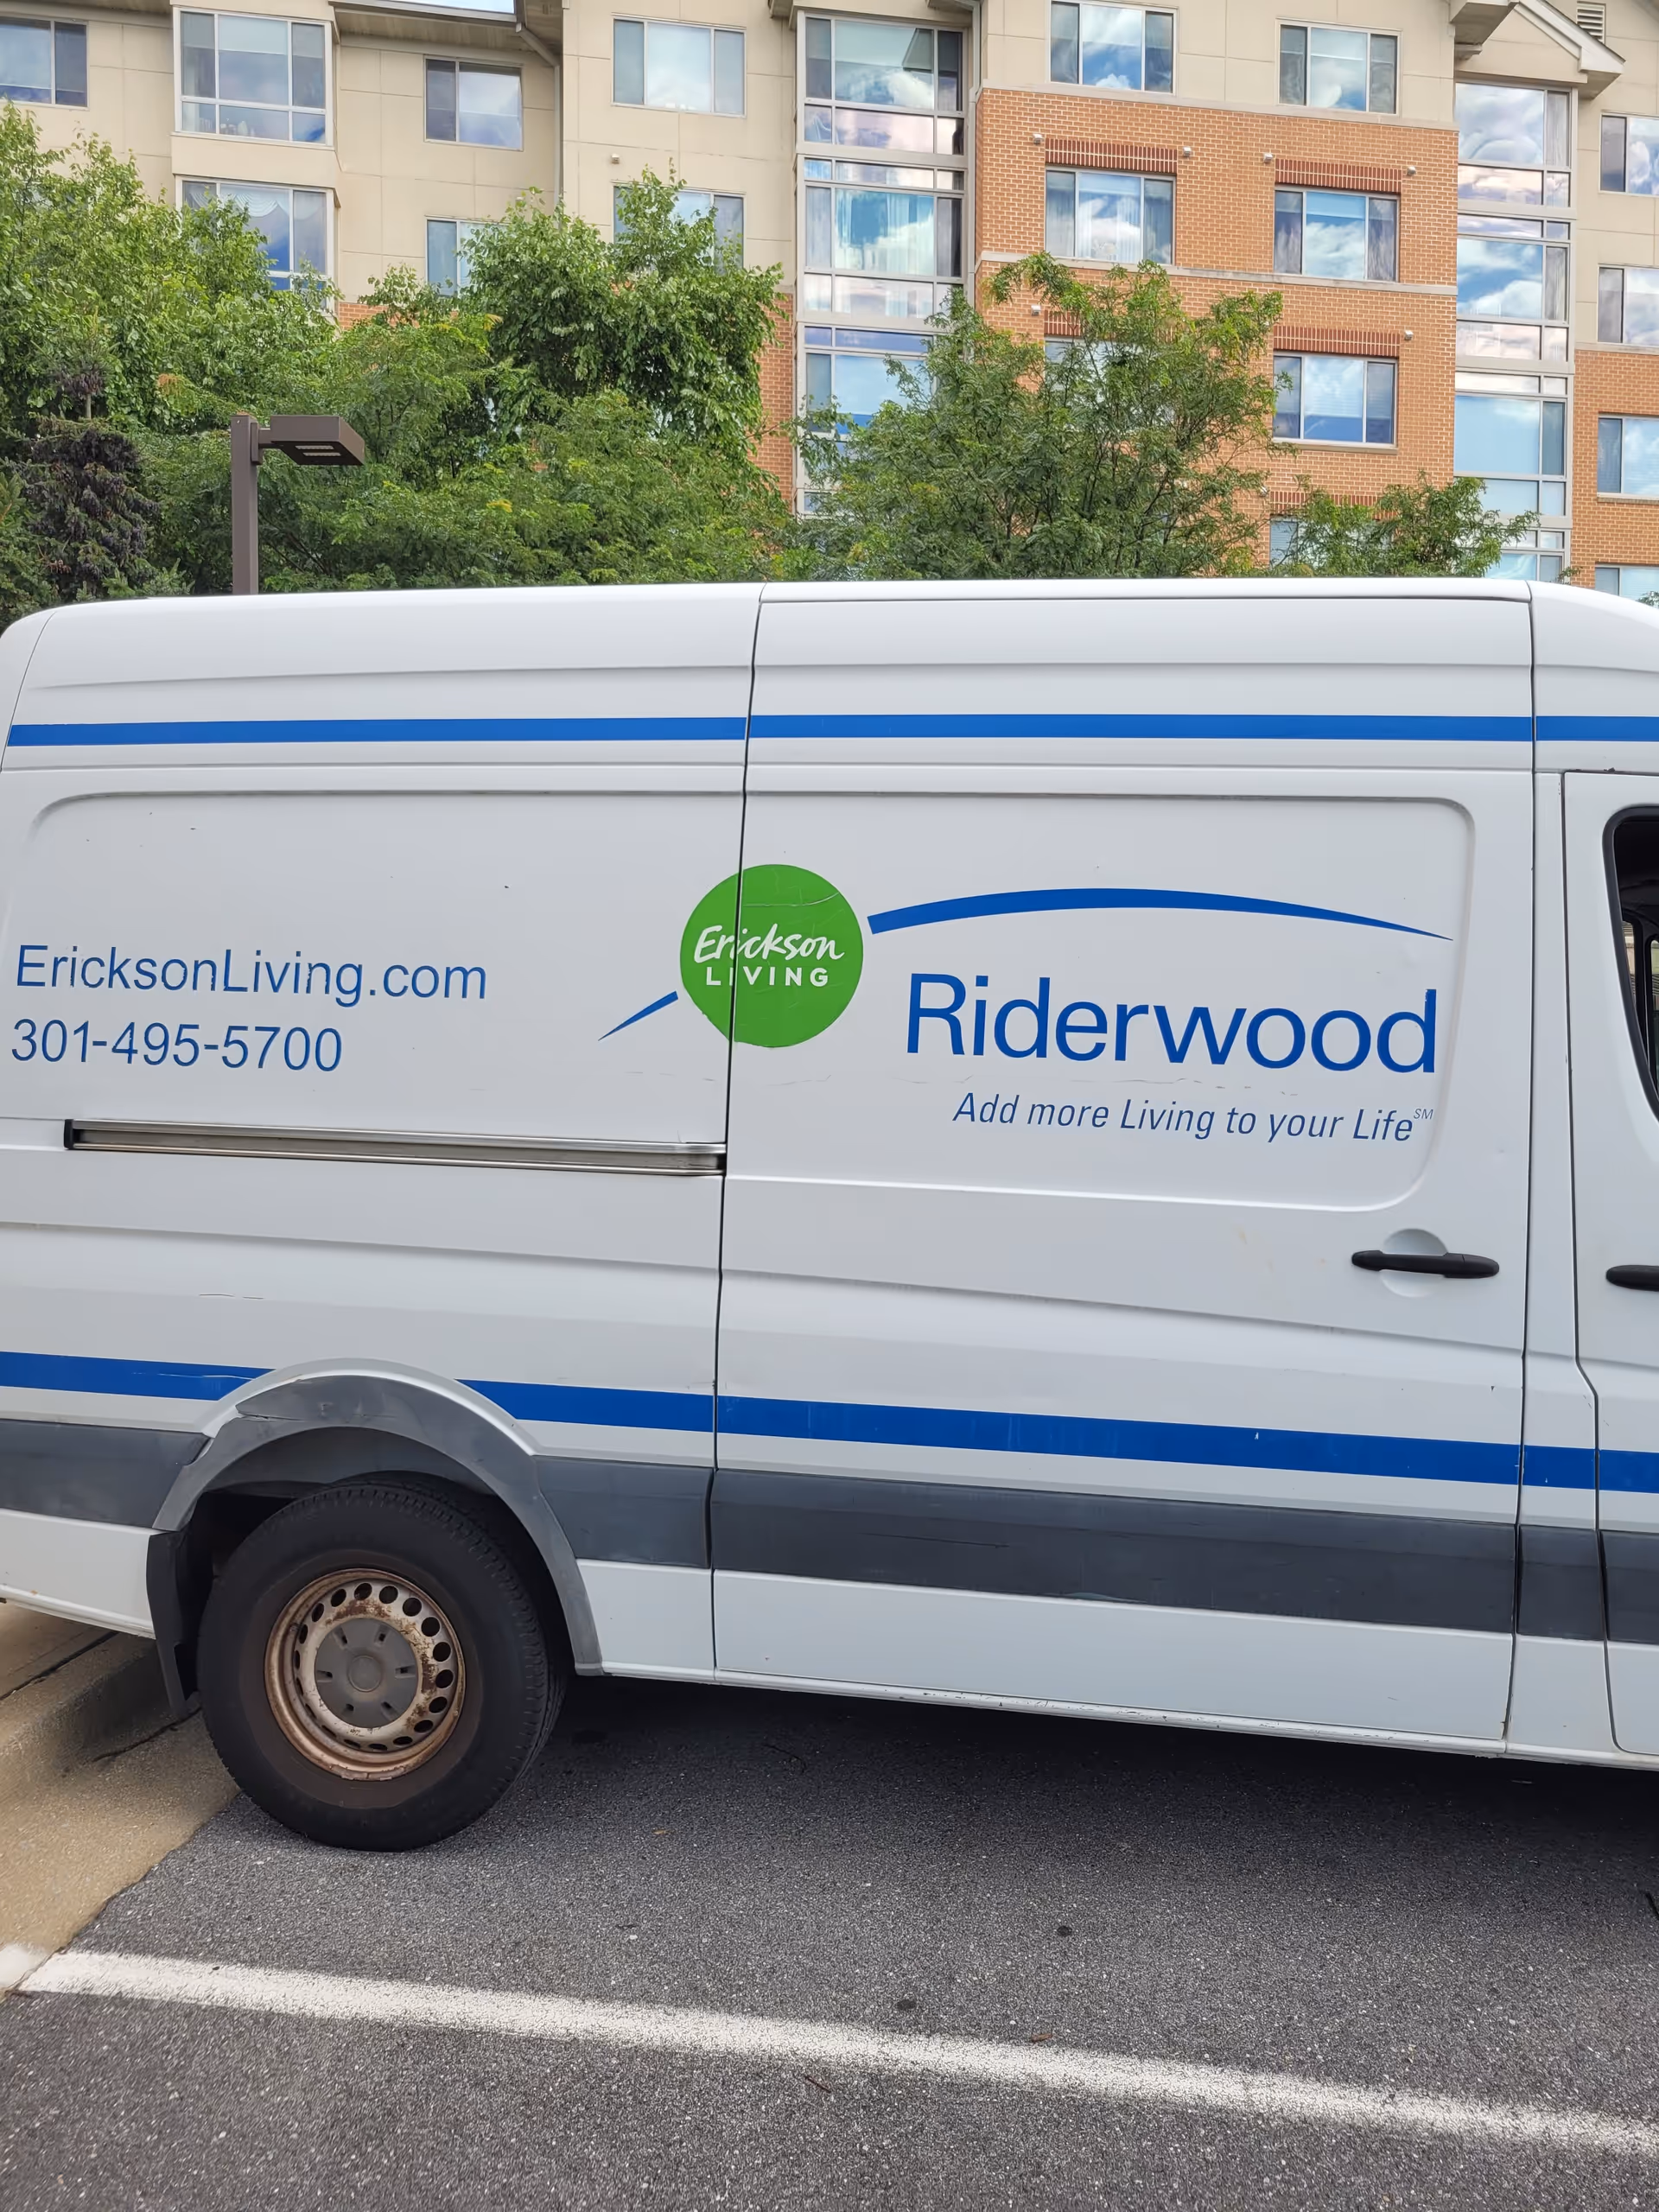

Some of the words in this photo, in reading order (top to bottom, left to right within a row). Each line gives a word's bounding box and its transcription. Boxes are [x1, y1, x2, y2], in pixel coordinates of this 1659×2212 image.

[694, 923, 845, 963] Erickson
[16, 944, 486, 1009] EricksonLiving.com
[706, 966, 830, 987] LIVING
[11, 1018, 343, 1072] 301-495-5700
[906, 972, 1438, 1074] Riderwood
[952, 1091, 1020, 1124] Add
[1027, 1103, 1110, 1128] more
[1120, 1099, 1215, 1141] Living
[1226, 1108, 1257, 1135] to
[1268, 1113, 1344, 1143] your
